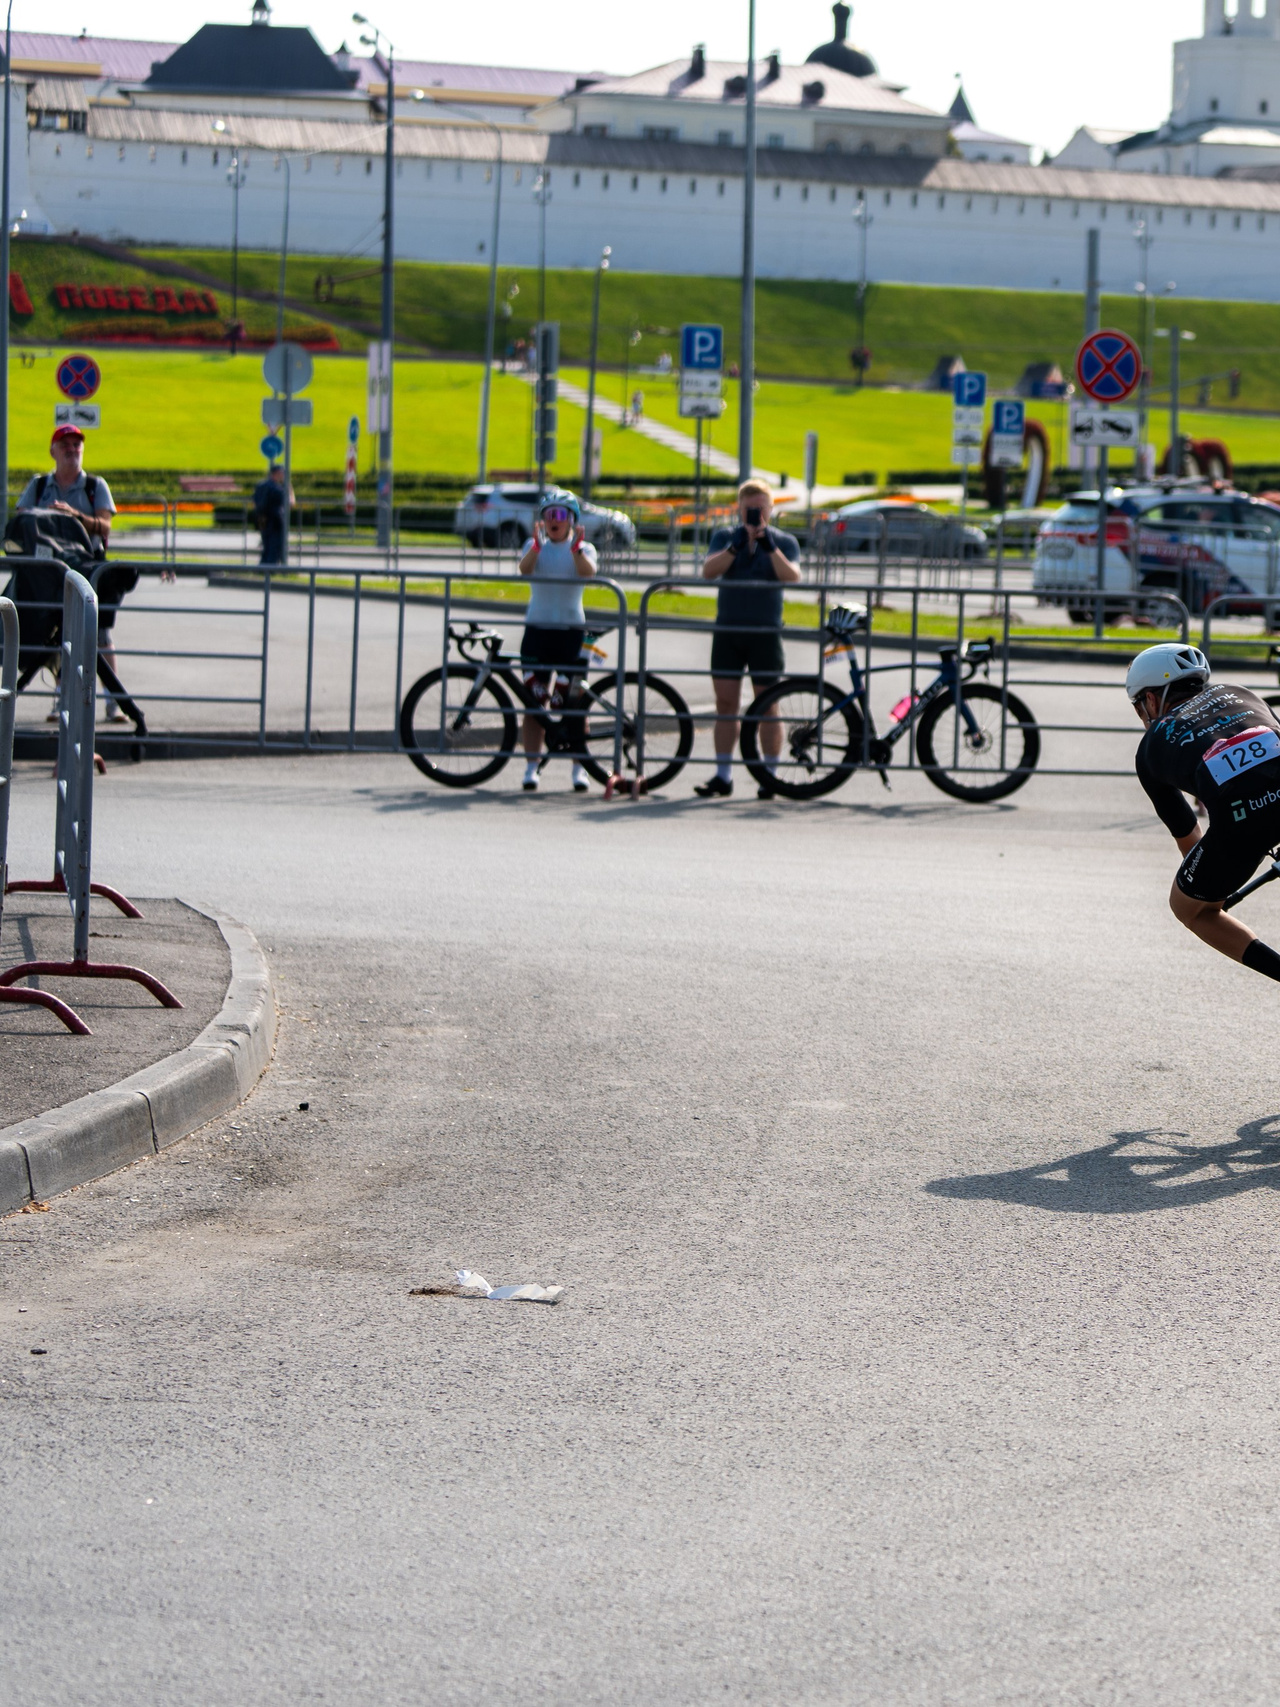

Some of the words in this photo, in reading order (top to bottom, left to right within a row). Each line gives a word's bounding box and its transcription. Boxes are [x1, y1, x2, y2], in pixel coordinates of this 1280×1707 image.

[694, 331, 715, 362] P
[1002, 404, 1019, 428] P
[1169, 713, 1209, 744] ULTIMA
[1212, 699, 1244, 714] AUTO
[1221, 741, 1267, 772] 128
